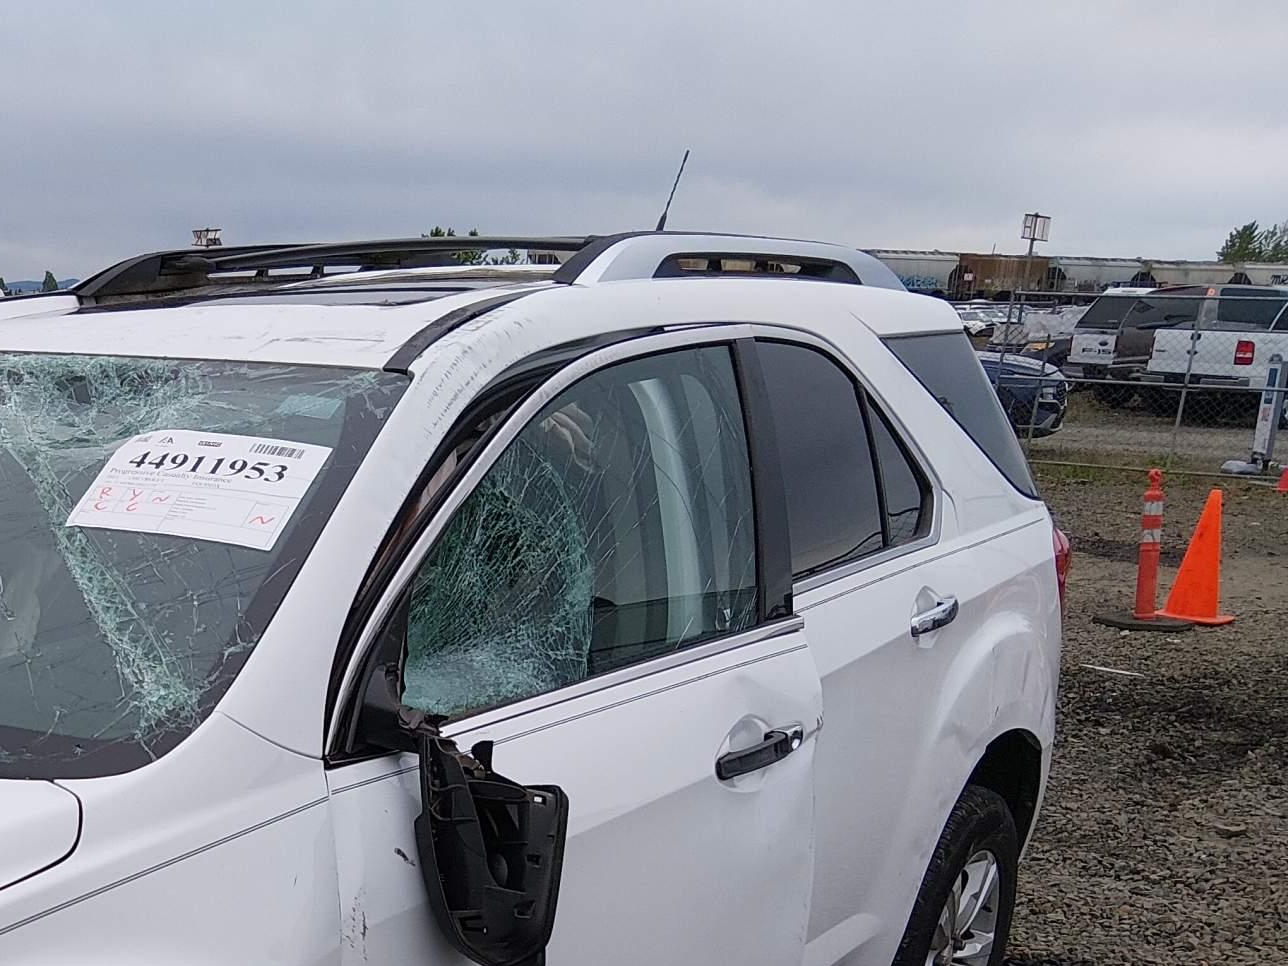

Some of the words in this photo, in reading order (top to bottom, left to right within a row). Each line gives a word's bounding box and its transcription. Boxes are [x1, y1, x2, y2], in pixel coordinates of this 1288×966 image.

[1082, 347, 1113, 355] F-15
[128, 450, 289, 484] 44911953
[99, 486, 113, 499] R
